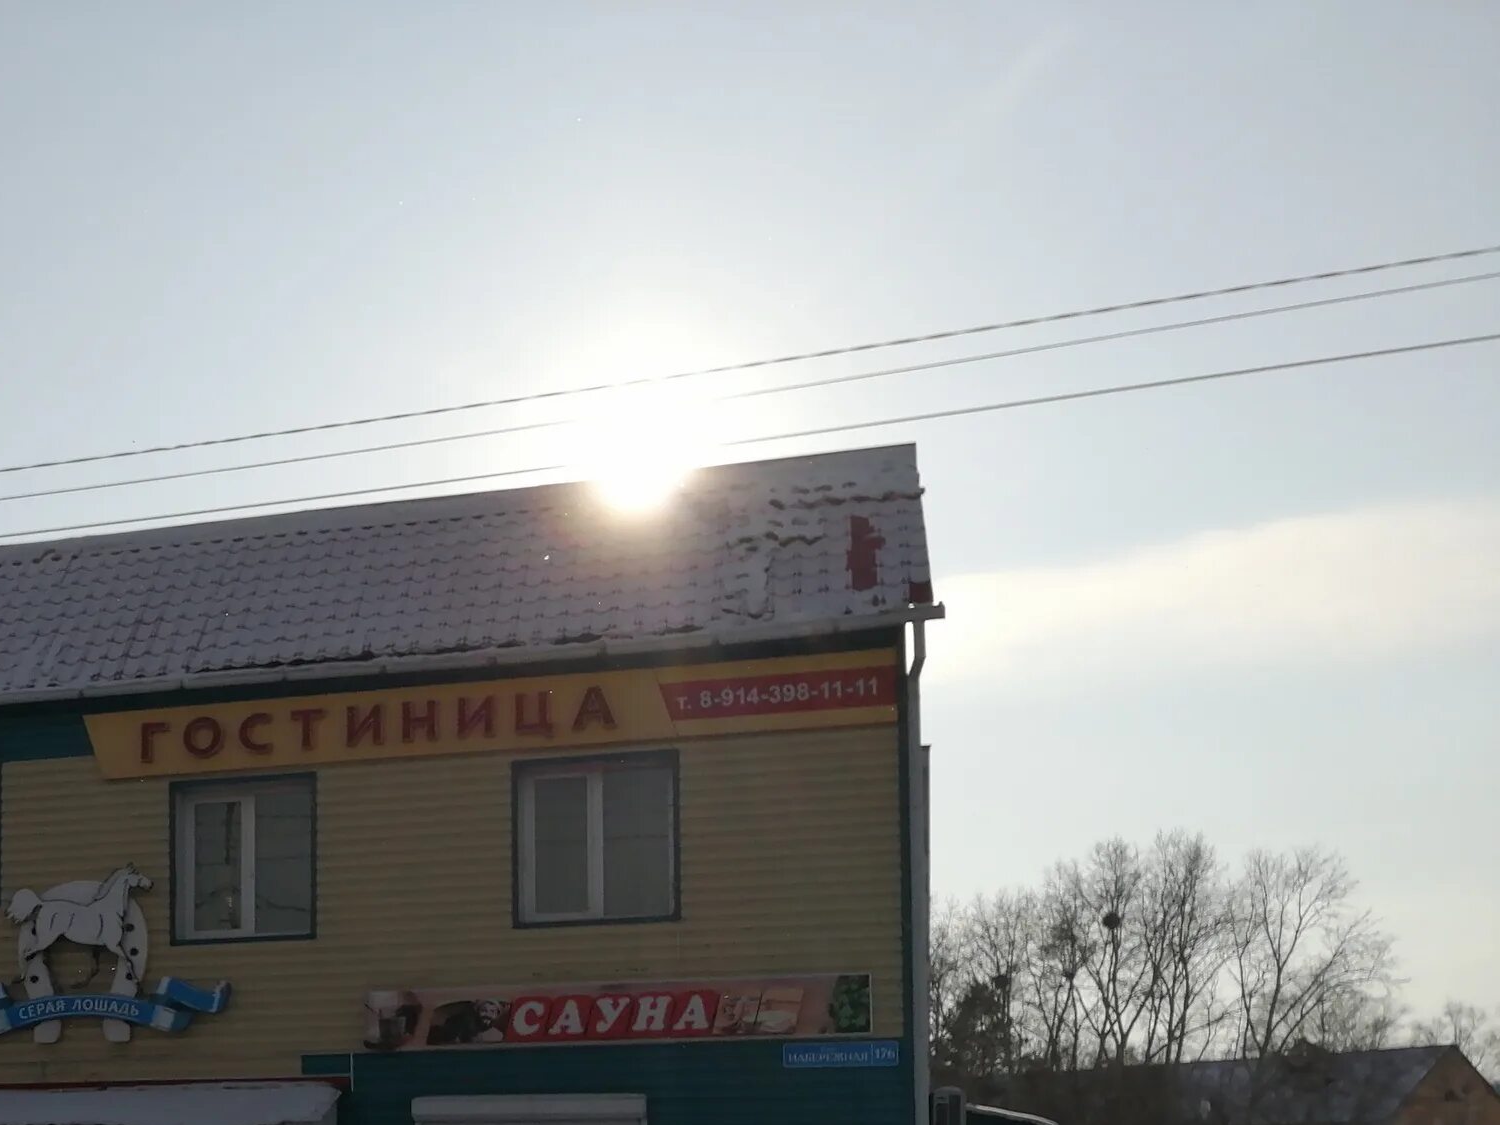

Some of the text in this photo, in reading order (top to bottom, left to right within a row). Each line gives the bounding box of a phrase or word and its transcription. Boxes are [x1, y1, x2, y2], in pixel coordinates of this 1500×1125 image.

[700, 676, 878, 708] 8-914-398-11-11
[140, 685, 617, 764] ГОСТИНИЦА
[19, 999, 140, 1020] СЕРАЯ ЛОШАДЬ
[513, 994, 710, 1036] САУНА
